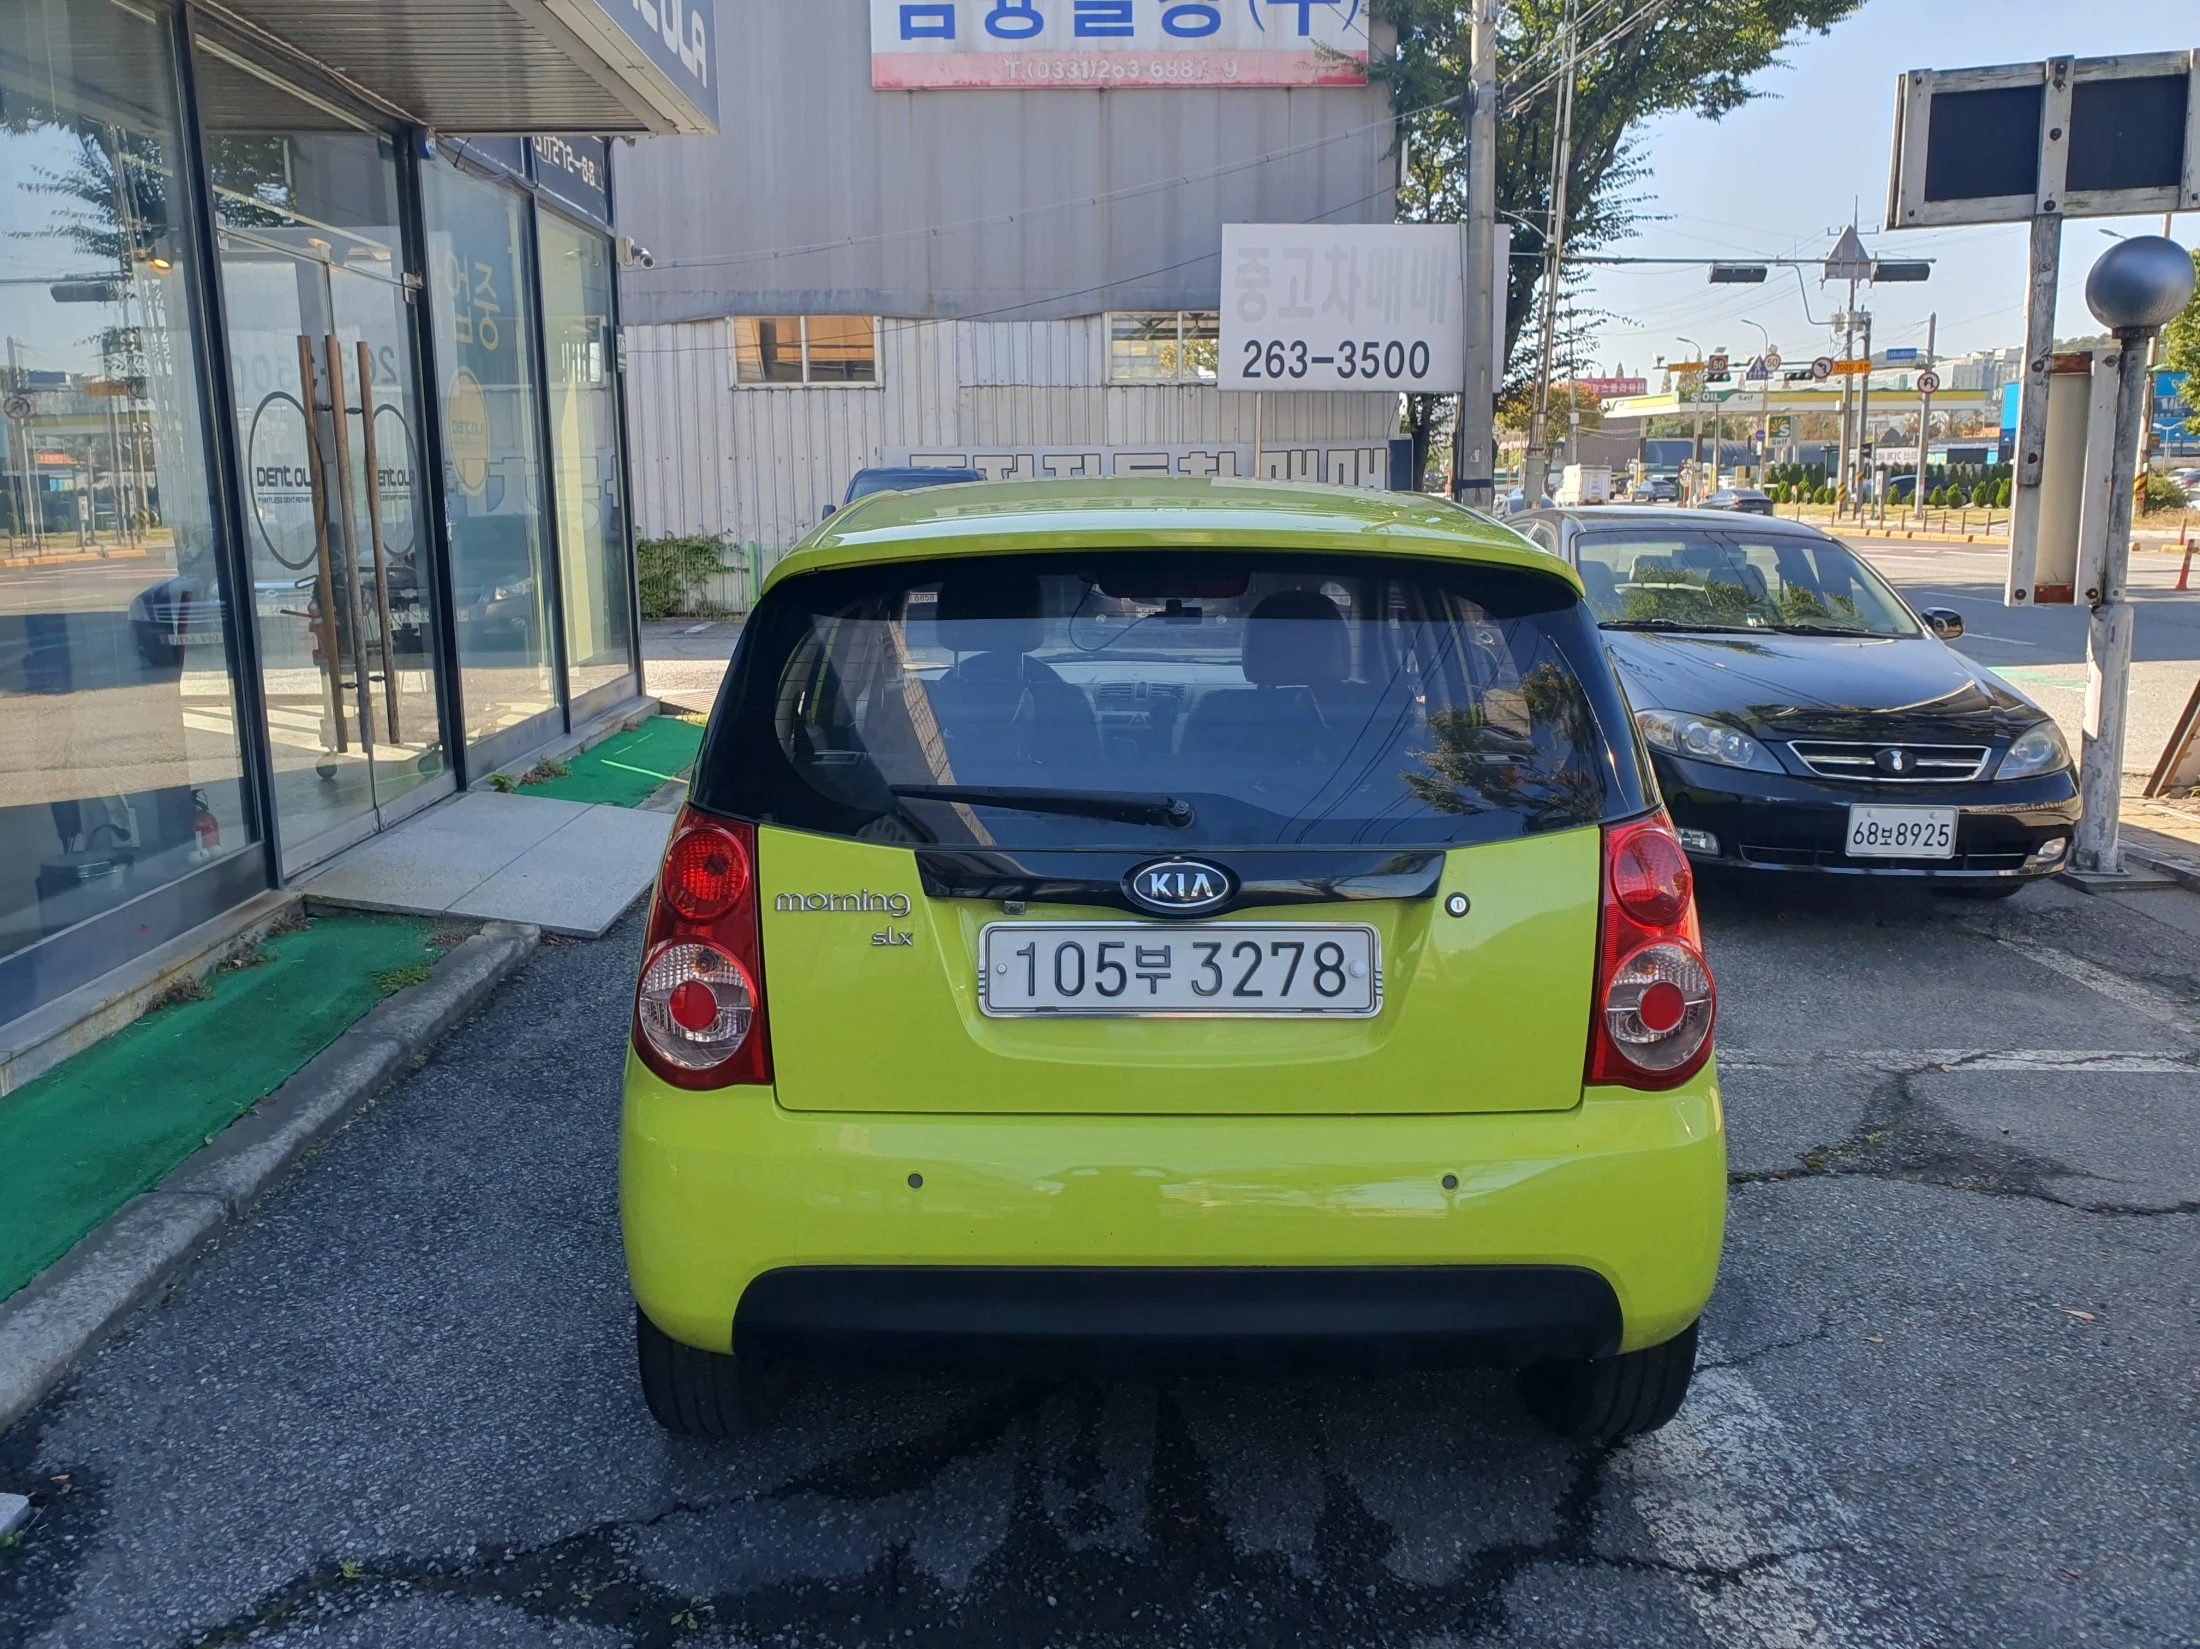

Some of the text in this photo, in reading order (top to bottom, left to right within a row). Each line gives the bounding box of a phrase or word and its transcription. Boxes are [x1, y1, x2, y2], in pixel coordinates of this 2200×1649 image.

[1234, 243, 1449, 324] 중고차매매
[1242, 339, 1430, 379] 263-3500
[1713, 360, 1724, 370] 50
[1690, 392, 1722, 402] SOIL
[294, 467, 312, 487] OL
[1853, 821, 1950, 847] 68보8925
[1149, 872, 1214, 898] KIA
[775, 888, 912, 917] morning
